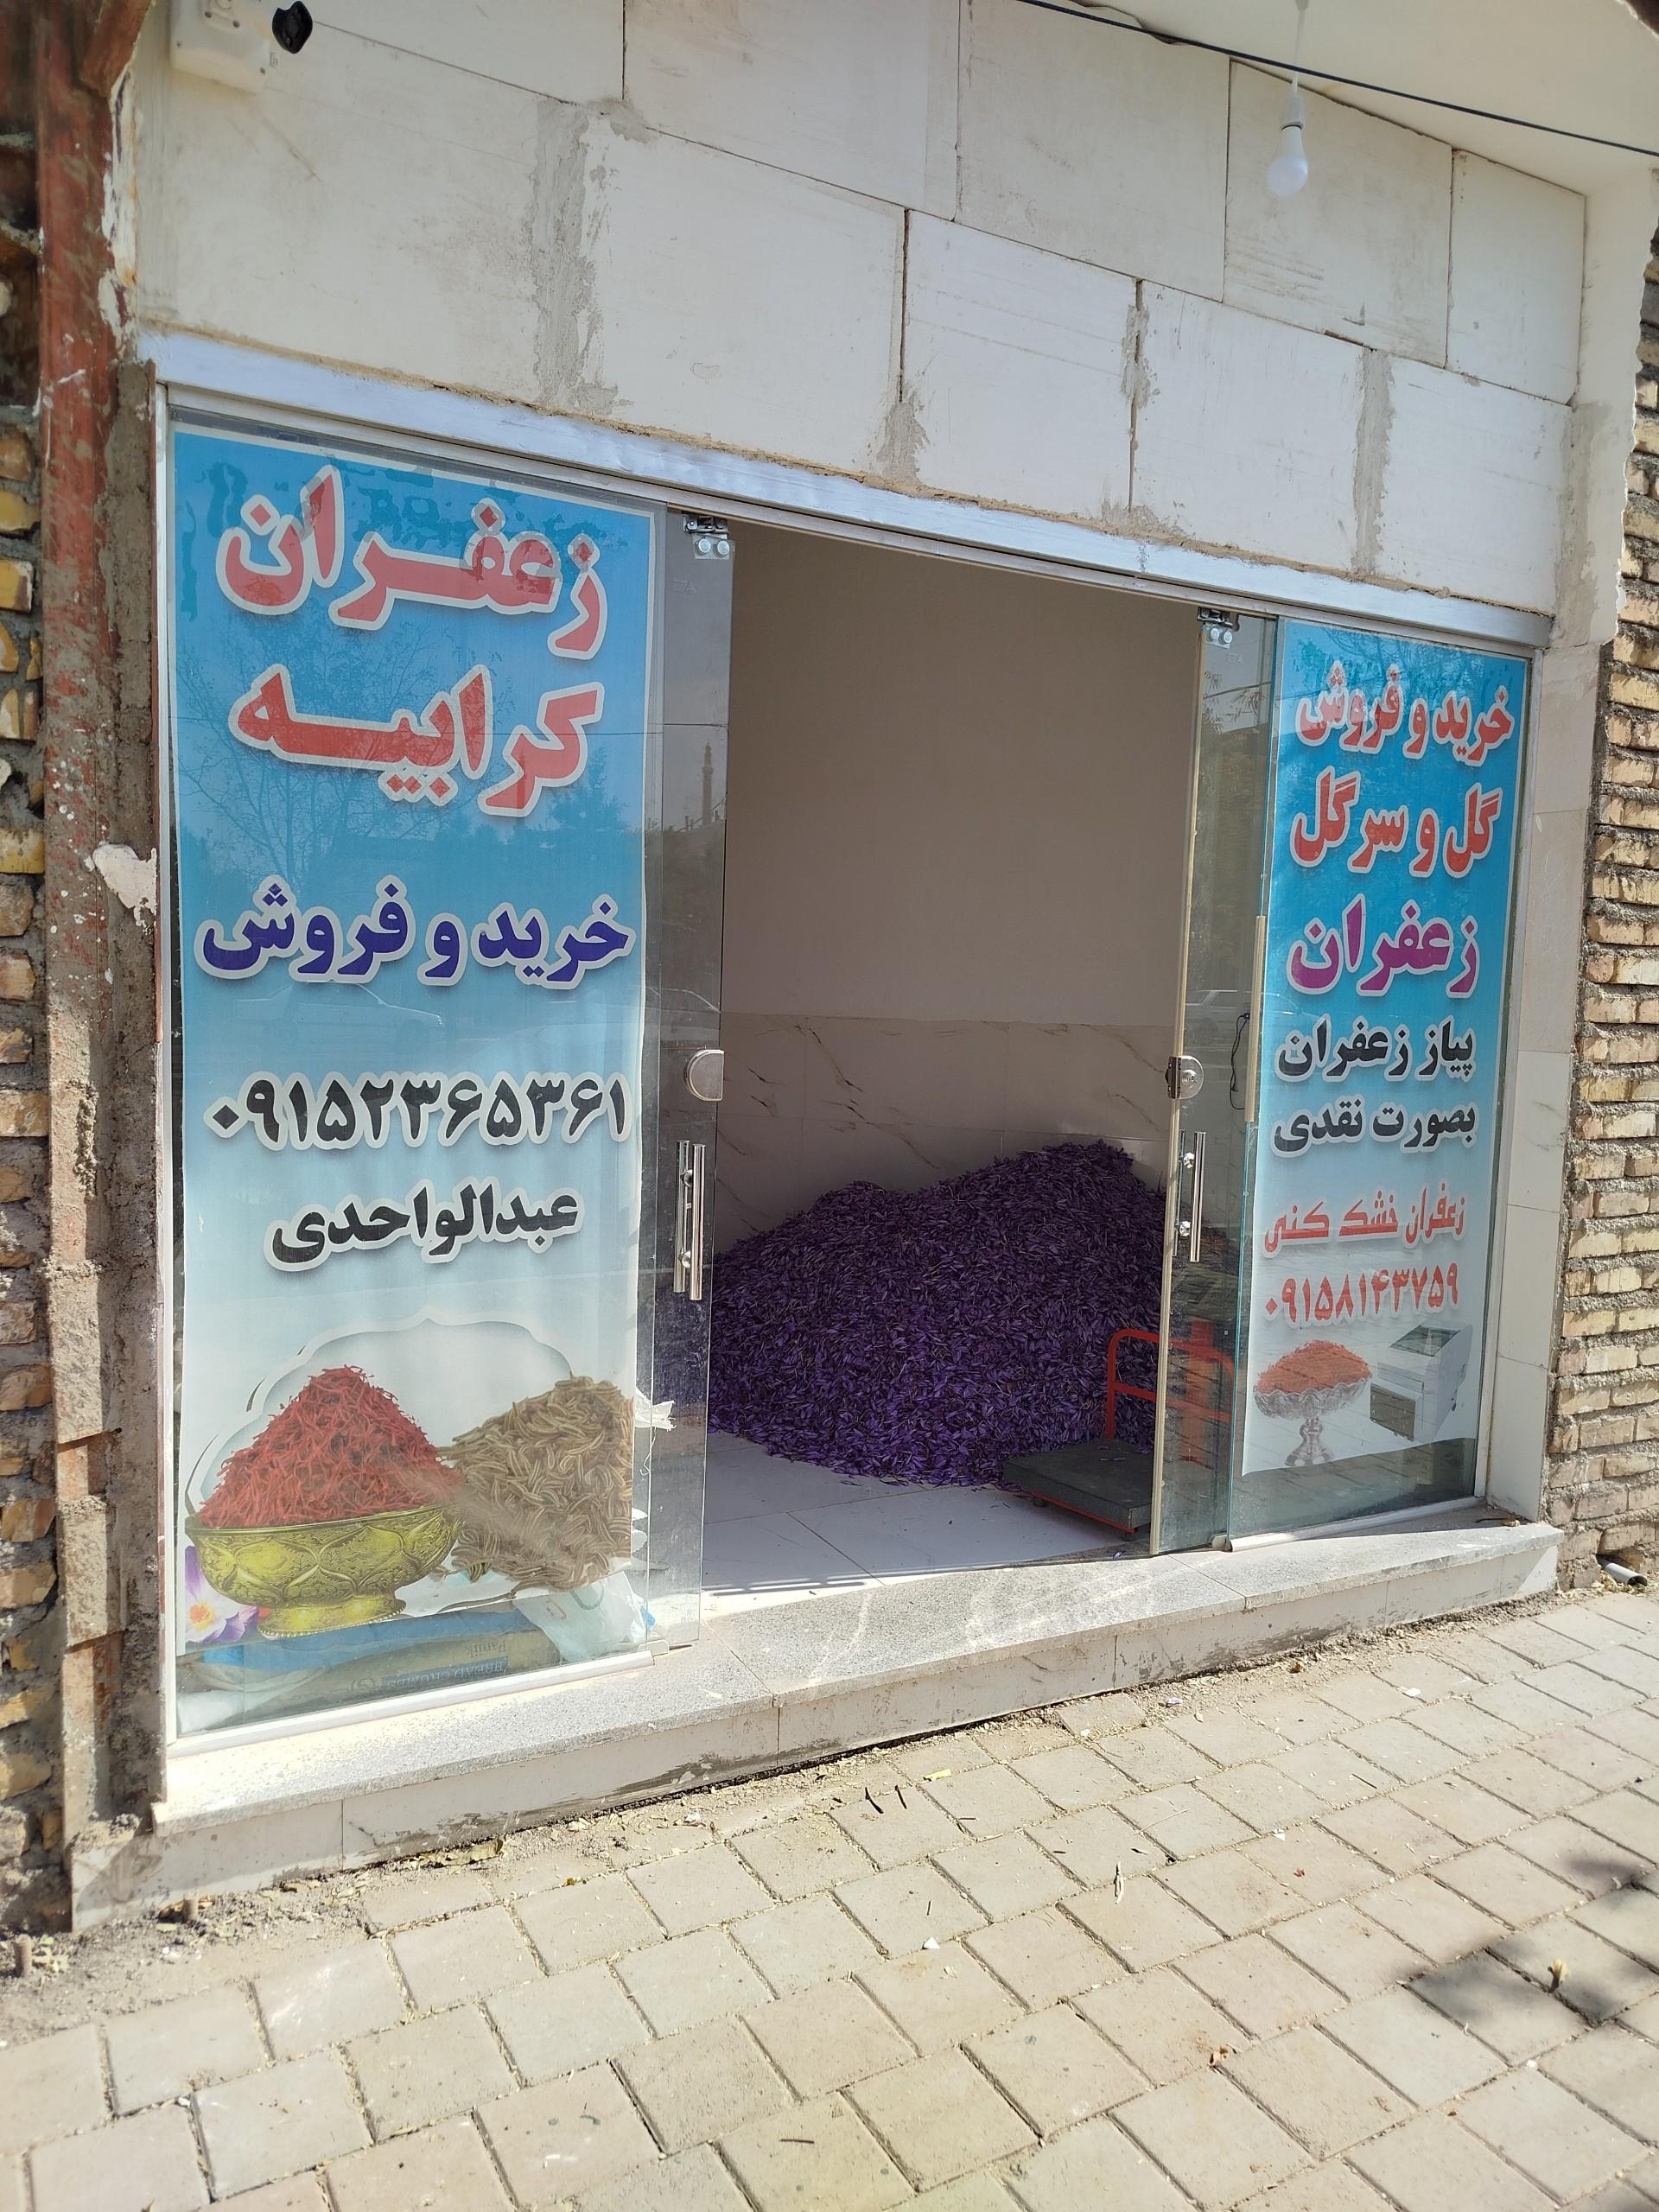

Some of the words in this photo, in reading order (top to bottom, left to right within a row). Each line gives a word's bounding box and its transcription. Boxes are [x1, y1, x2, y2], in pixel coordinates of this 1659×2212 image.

[220, 469, 605, 657] زعفران
[1297, 664, 1403, 751] فروش
[1404, 702, 1429, 756] و
[1433, 689, 1513, 763] خرید
[1411, 810, 1438, 874] و
[1444, 785, 1503, 874] گل
[200, 880, 411, 979] فروش
[424, 918, 463, 980] و
[475, 898, 632, 984] خرید
[1288, 896, 1478, 995] زعفران
[1276, 1017, 1411, 1078] زعفران
[1417, 1018, 1474, 1078] پیاز
[210, 1077, 628, 1146] ۰۹۱۵۲۳۶۵۳۶۱
[1272, 1096, 1364, 1154] نقدی
[1370, 1104, 1478, 1150] بصورت
[1262, 1199, 1332, 1255] کنی
[1338, 1188, 1401, 1238] خشک
[1403, 1180, 1467, 1246] زعفران
